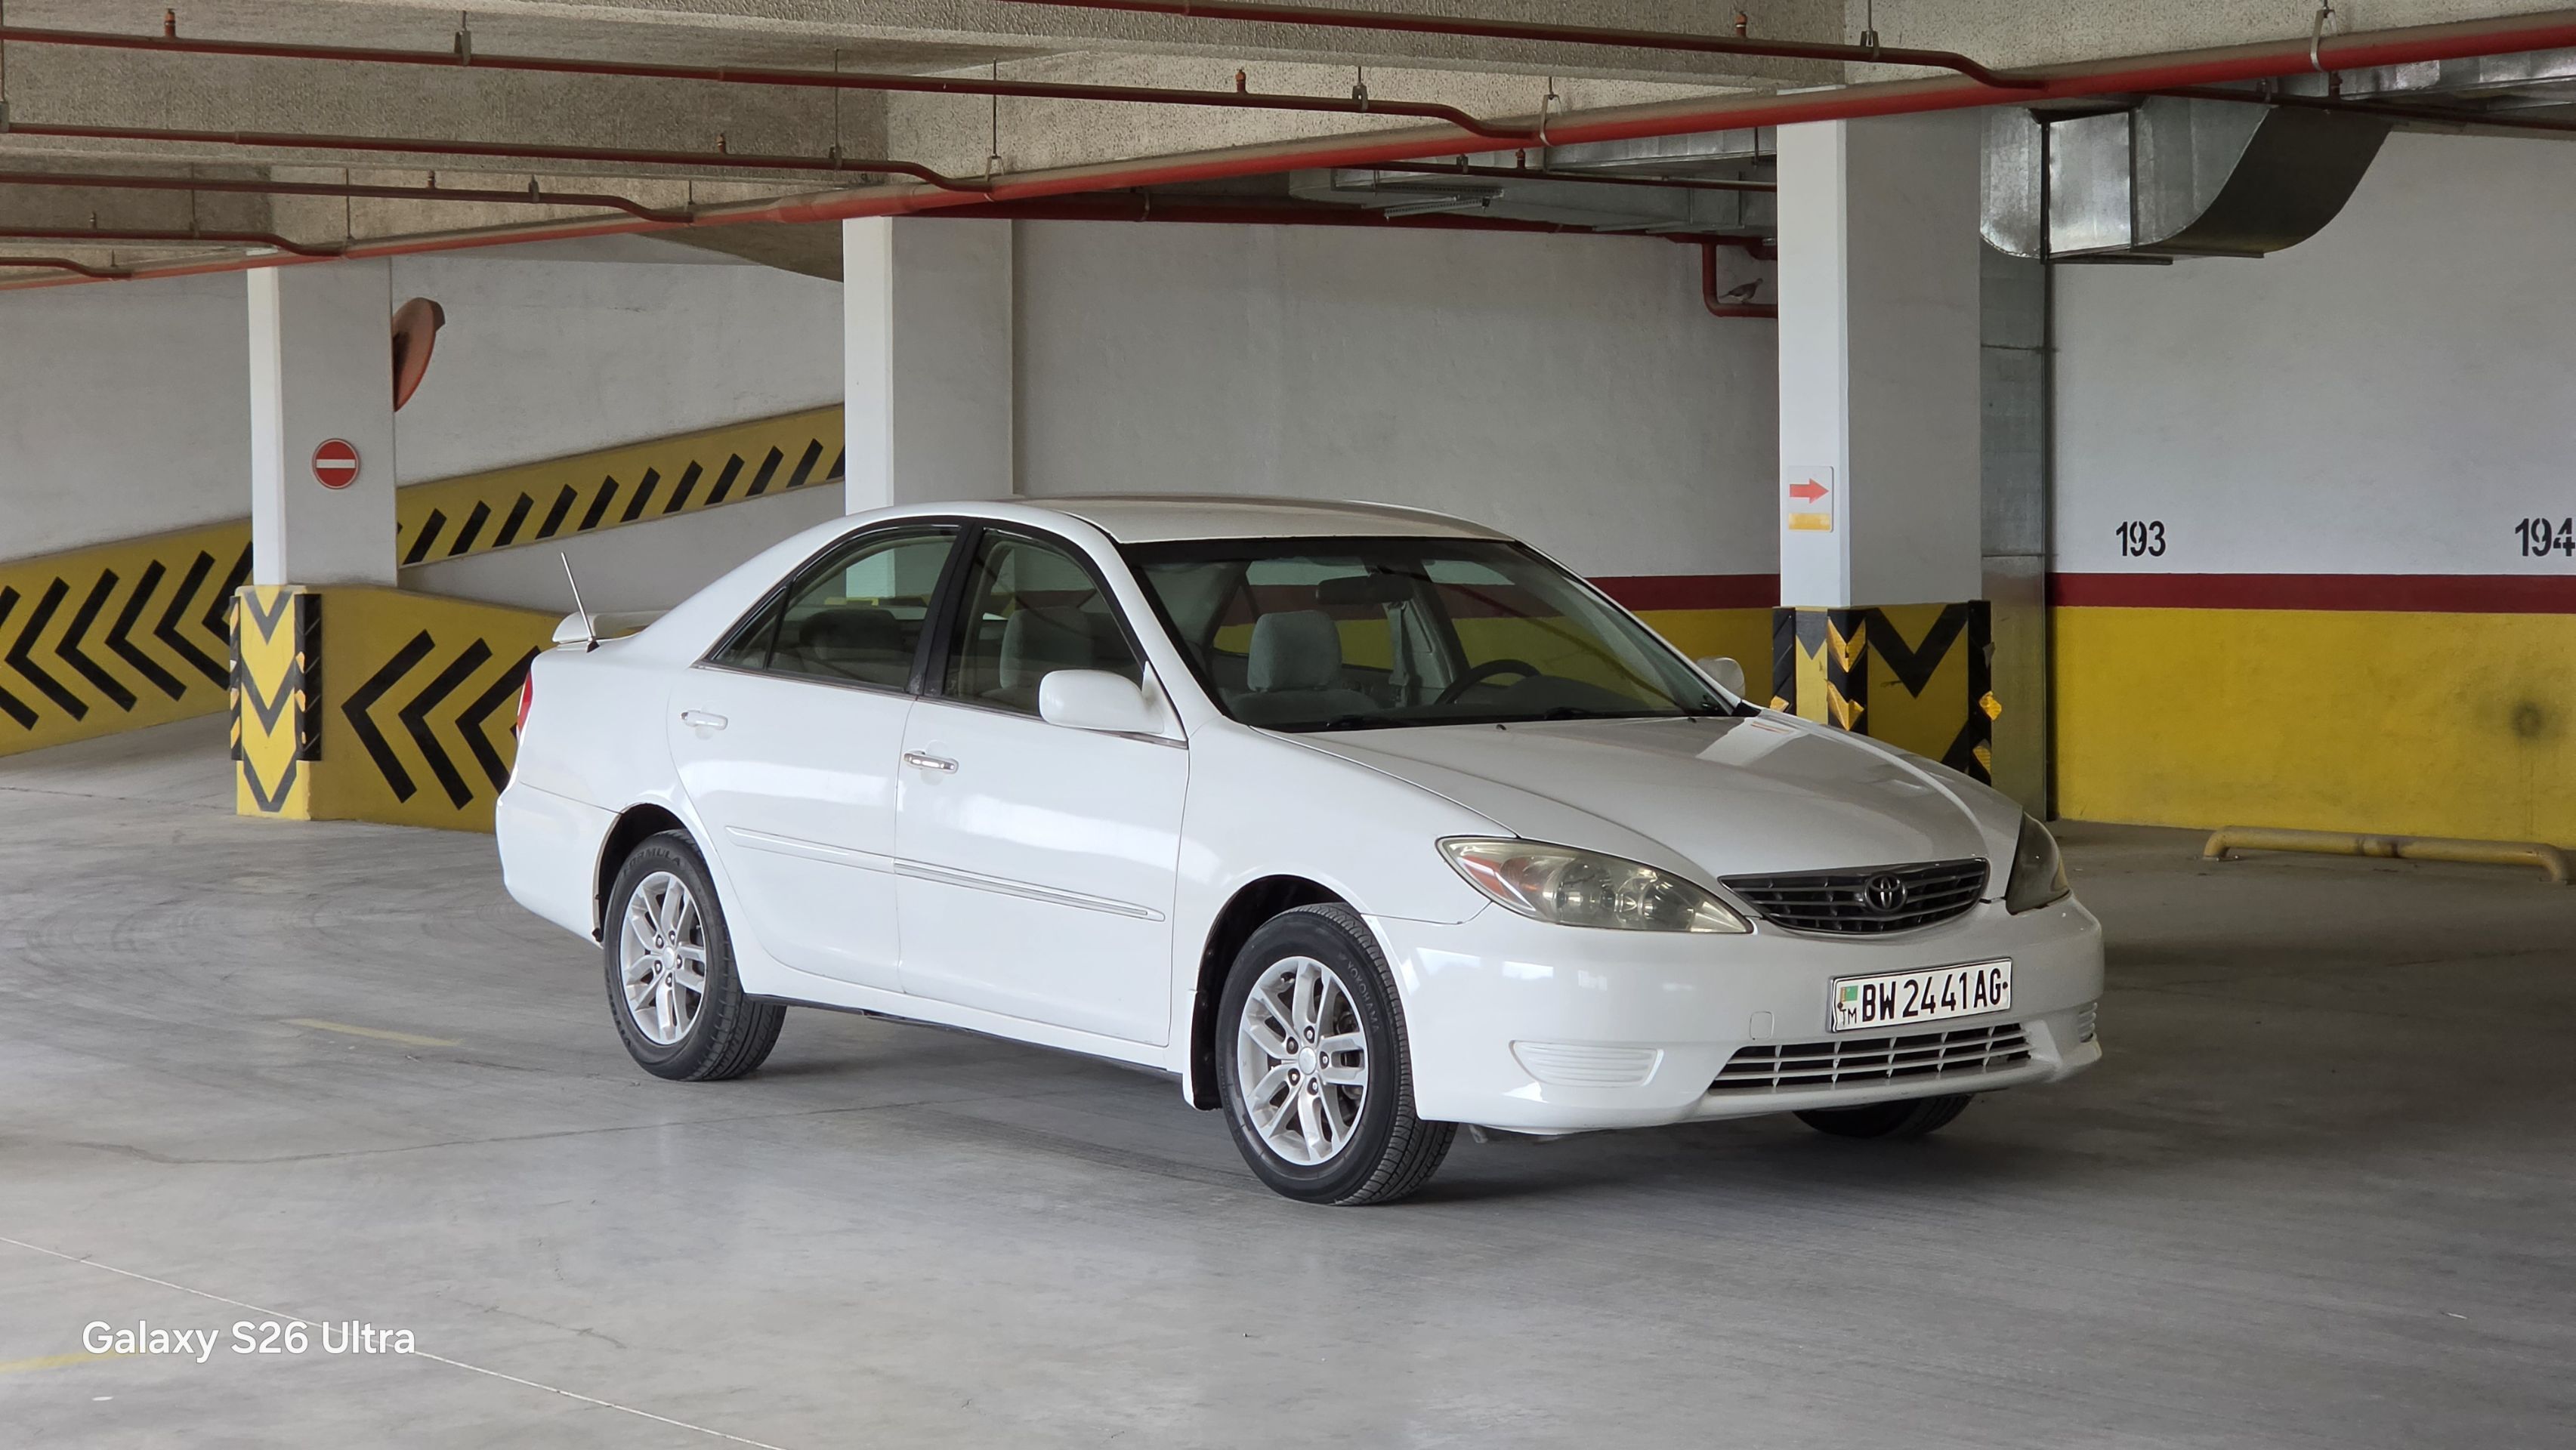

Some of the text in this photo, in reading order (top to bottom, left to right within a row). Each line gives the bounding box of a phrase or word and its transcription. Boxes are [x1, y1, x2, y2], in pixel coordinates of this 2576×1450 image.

[2115, 520, 2167, 557] 193
[2515, 517, 2576, 557] 194
[1348, 961, 1379, 1034] YOKOHAMA
[1840, 1007, 1858, 1026] TM
